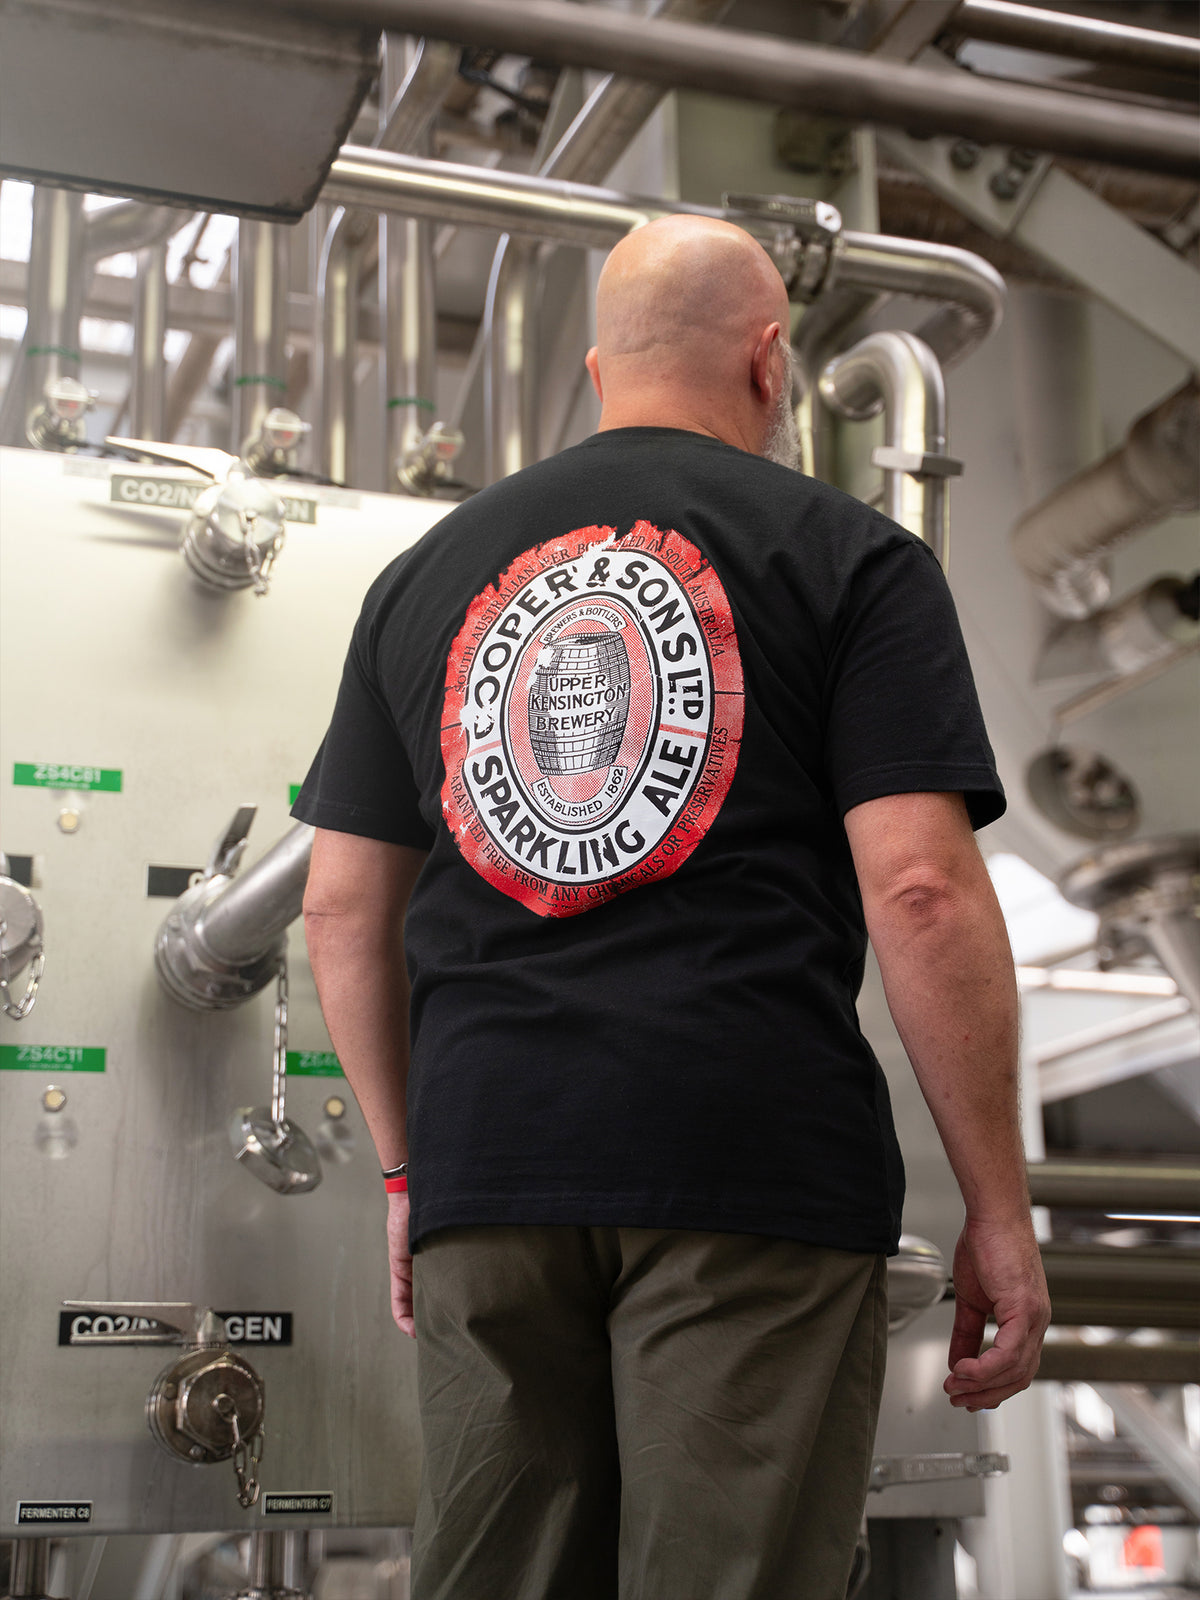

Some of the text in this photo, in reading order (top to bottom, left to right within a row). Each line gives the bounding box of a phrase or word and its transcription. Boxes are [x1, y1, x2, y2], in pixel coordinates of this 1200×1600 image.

[471, 565, 535, 641] AUSTRALIAN
[689, 584, 725, 657] AUSTRALIA
[586, 557, 610, 587] &
[616, 561, 697, 662] SONS
[544, 612, 577, 641] BREWERS
[531, 683, 627, 711] KENSINGTON
[549, 674, 607, 692] UPPER
[536, 706, 616, 731] BREWERY
[537, 768, 623, 816] ESTABLISHED 1862
[472, 739, 698, 875] SPARKLING ALE
[483, 842, 511, 876] FREE
[513, 869, 548, 897] FROM
[551, 886, 581, 902] ANY
[661, 834, 684, 856] OR
[677, 727, 728, 833] PRESERVATIVES
[20, 1507, 77, 1519] FERMENTER
[266, 1498, 319, 1510] FERMENTER
